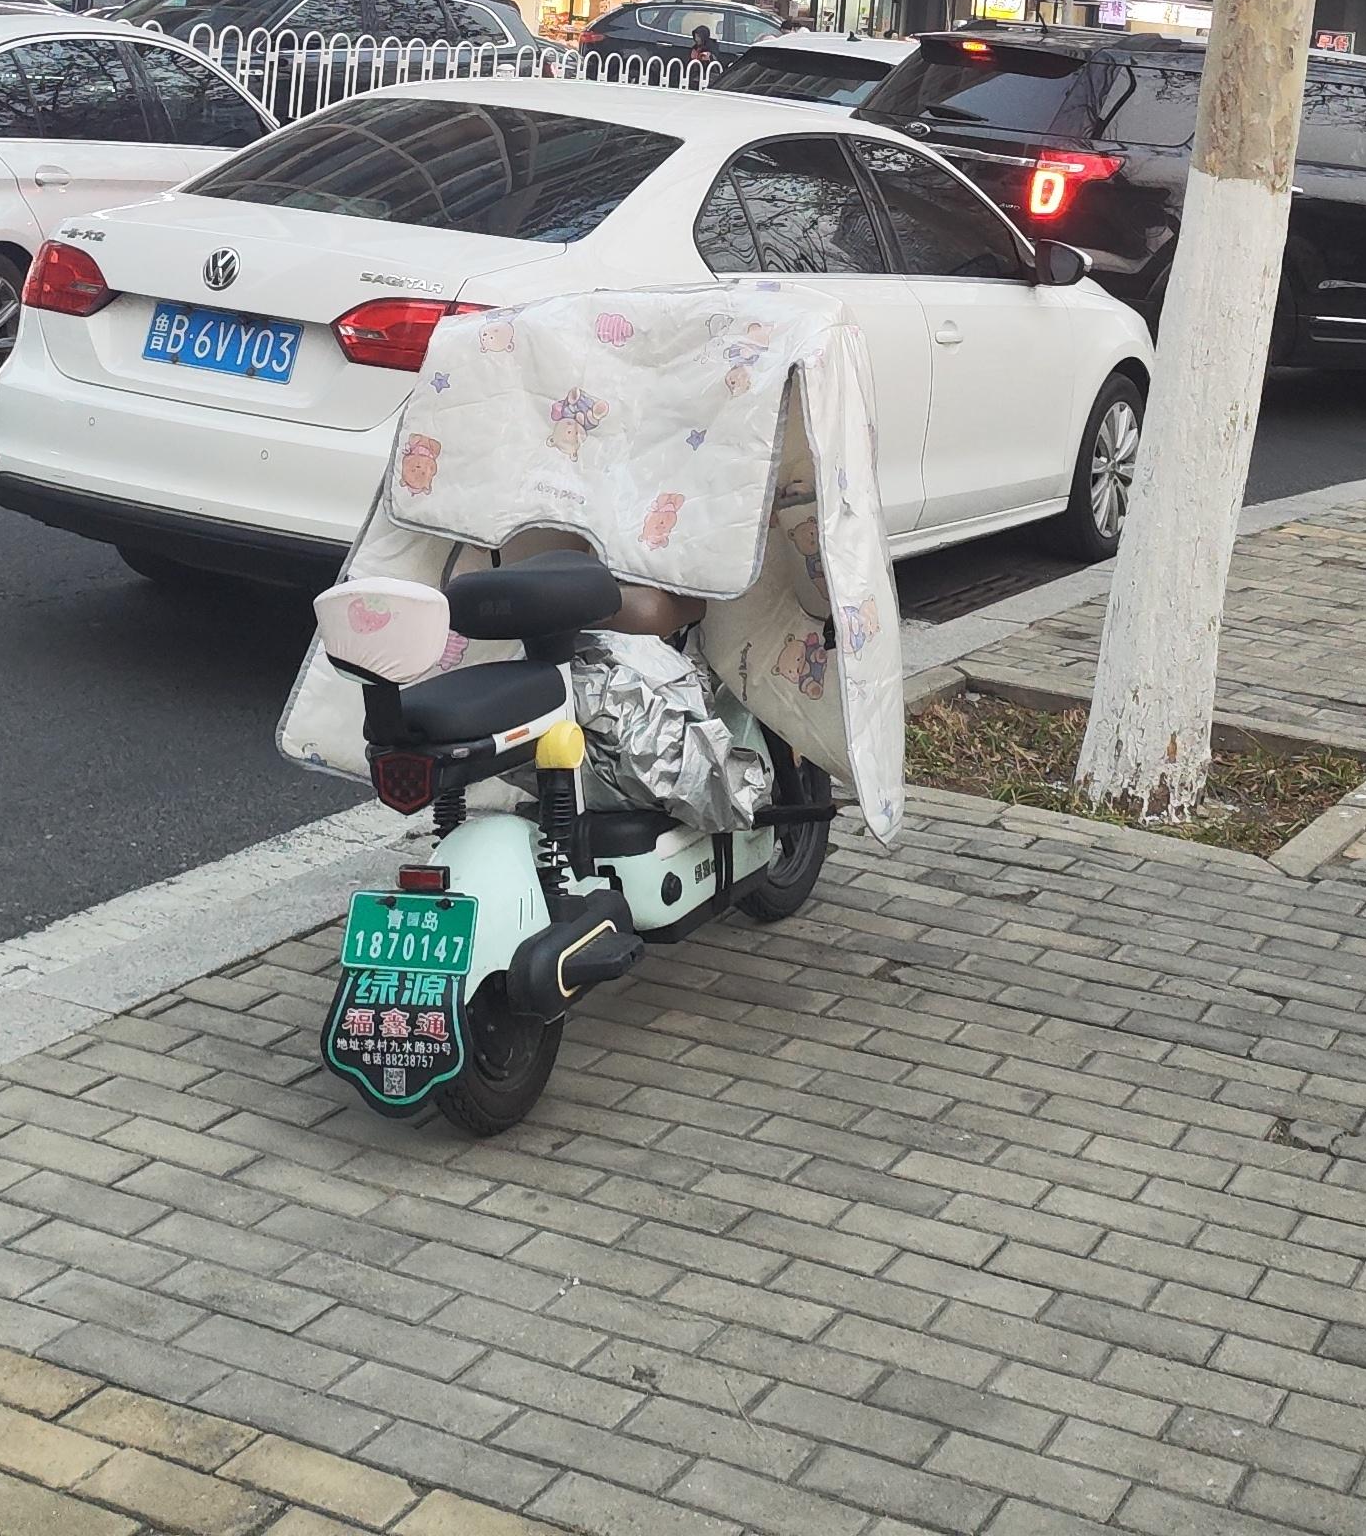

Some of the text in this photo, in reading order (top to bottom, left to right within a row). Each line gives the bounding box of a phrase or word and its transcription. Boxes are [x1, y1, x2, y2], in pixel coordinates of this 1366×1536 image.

[359, 271, 445, 295] SAGITAR
[150, 310, 297, 374] 鲁B·6VY03
[354, 930, 465, 964] 1870147
[354, 969, 447, 1006] 绿源
[341, 1007, 450, 1042] 福鑫通
[336, 1037, 452, 1056] 地址:李村九水路39号
[362, 1052, 434, 1068] 电话:88238757
